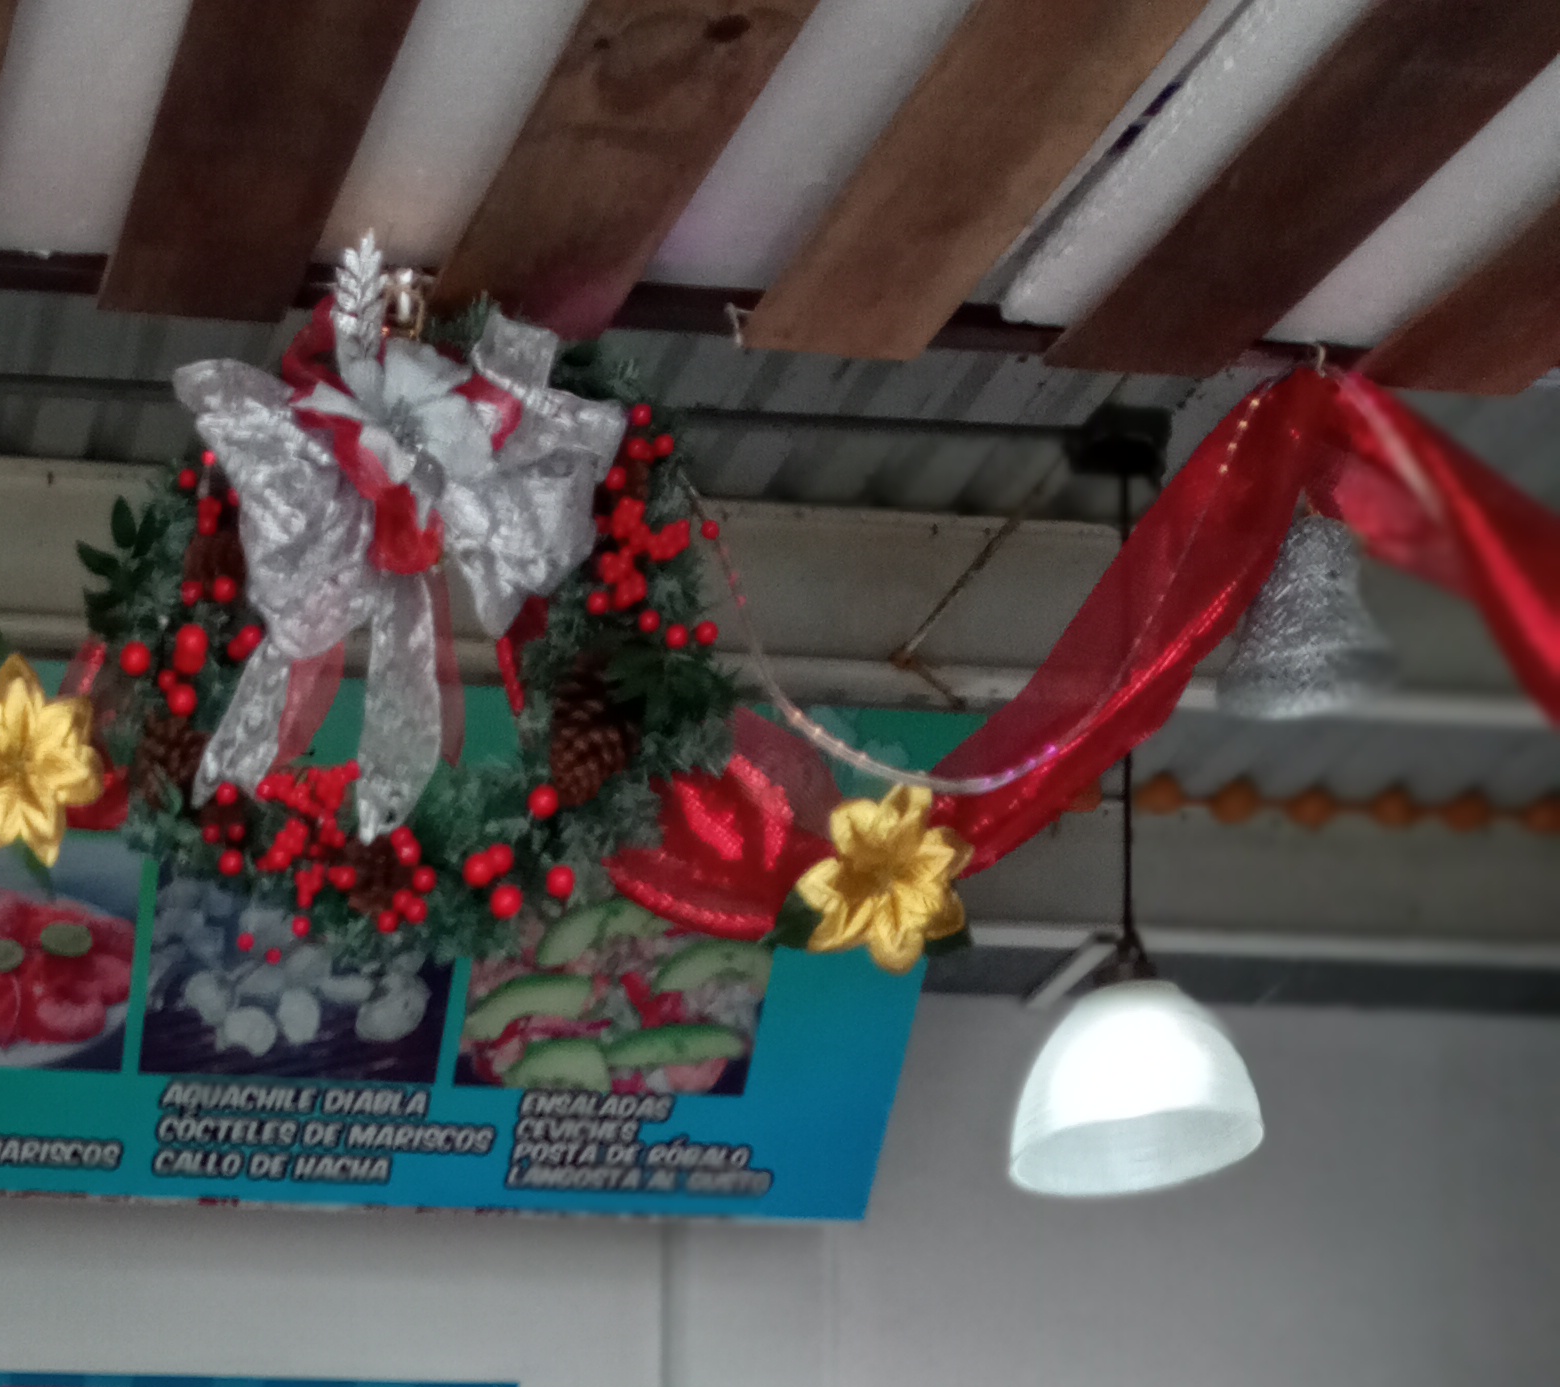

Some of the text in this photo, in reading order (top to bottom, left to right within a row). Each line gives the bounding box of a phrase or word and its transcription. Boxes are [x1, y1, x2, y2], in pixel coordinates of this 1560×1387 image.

[321, 1088, 429, 1118] DIABLA
[519, 1091, 674, 1121] ENSALADAS
[301, 1122, 342, 1148] DE
[346, 1124, 496, 1153] MARISCOS
[152, 1149, 390, 1182] CALLO DE HACHA
[512, 1143, 599, 1165] POSTA
